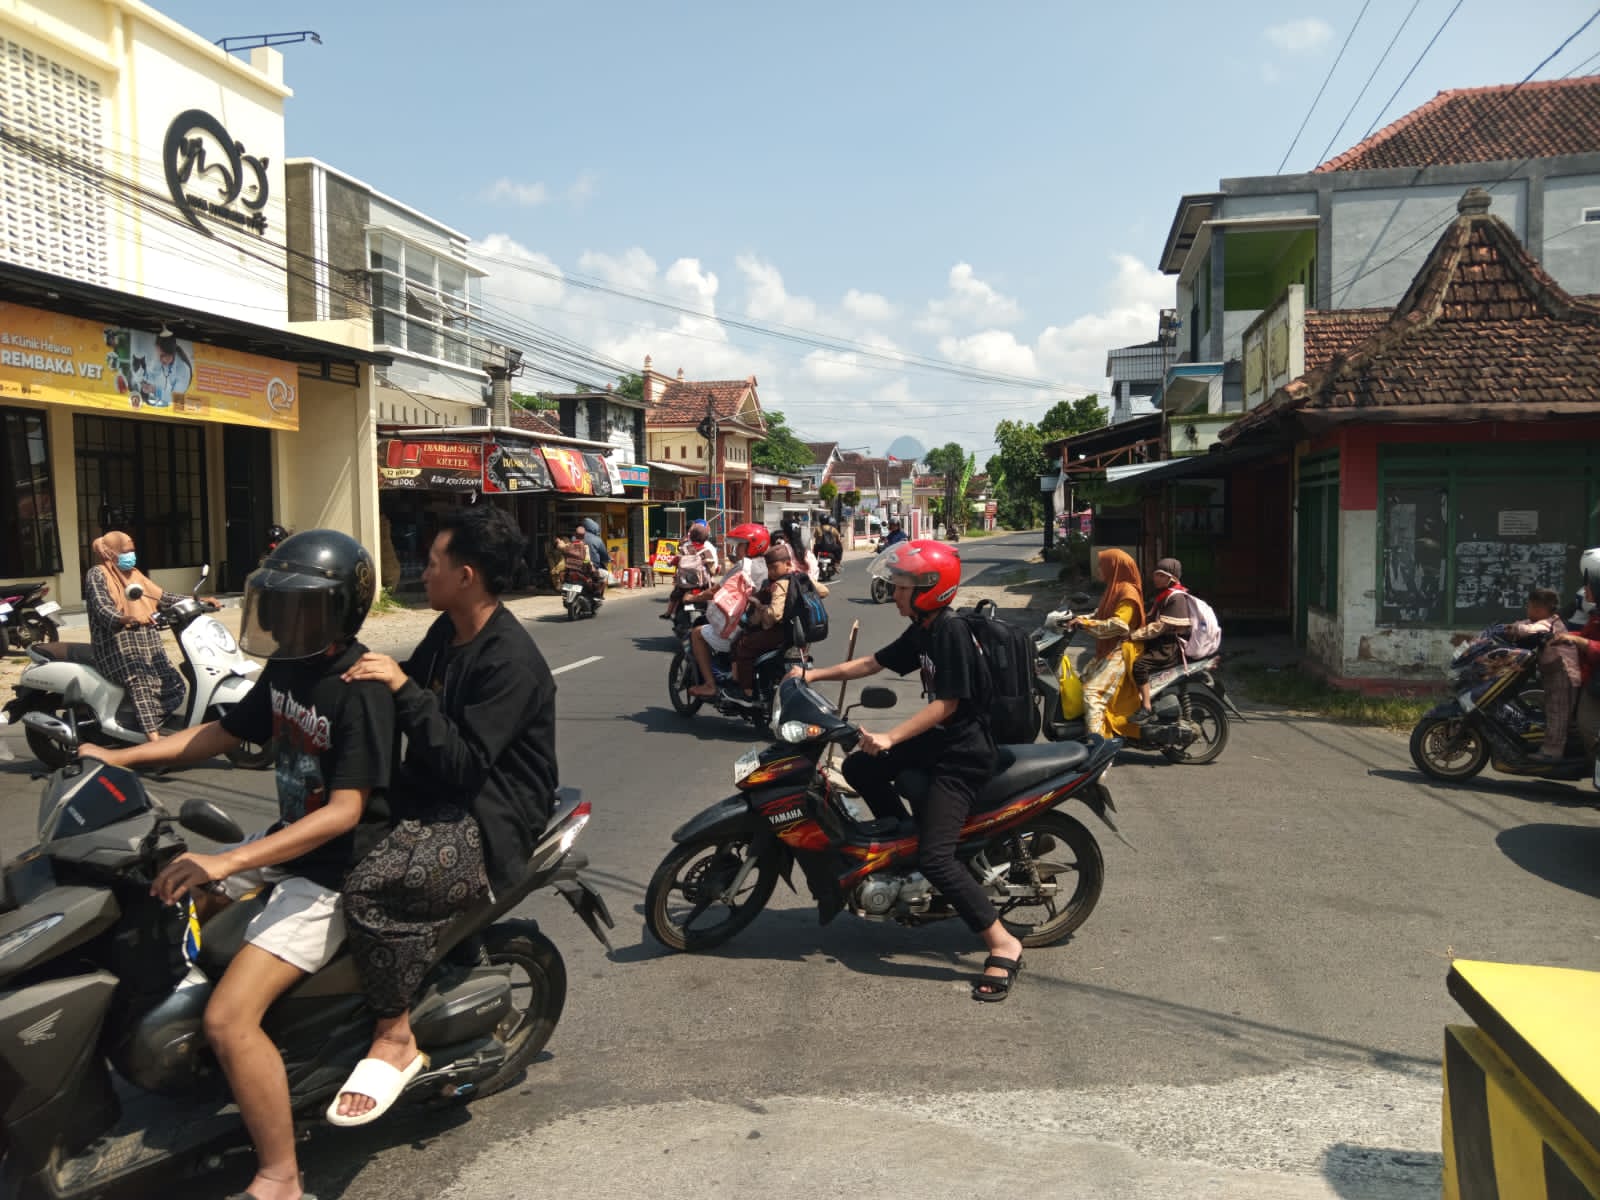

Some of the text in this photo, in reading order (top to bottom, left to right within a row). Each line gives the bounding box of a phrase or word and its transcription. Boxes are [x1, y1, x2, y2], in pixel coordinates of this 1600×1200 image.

[11, 335, 39, 350] Klinik
[40, 339, 73, 355] Hewan
[0, 350, 104, 379] REMBAKA VET
[436, 457, 469, 467] KRETEK
[768, 808, 803, 825] YAMAHA
